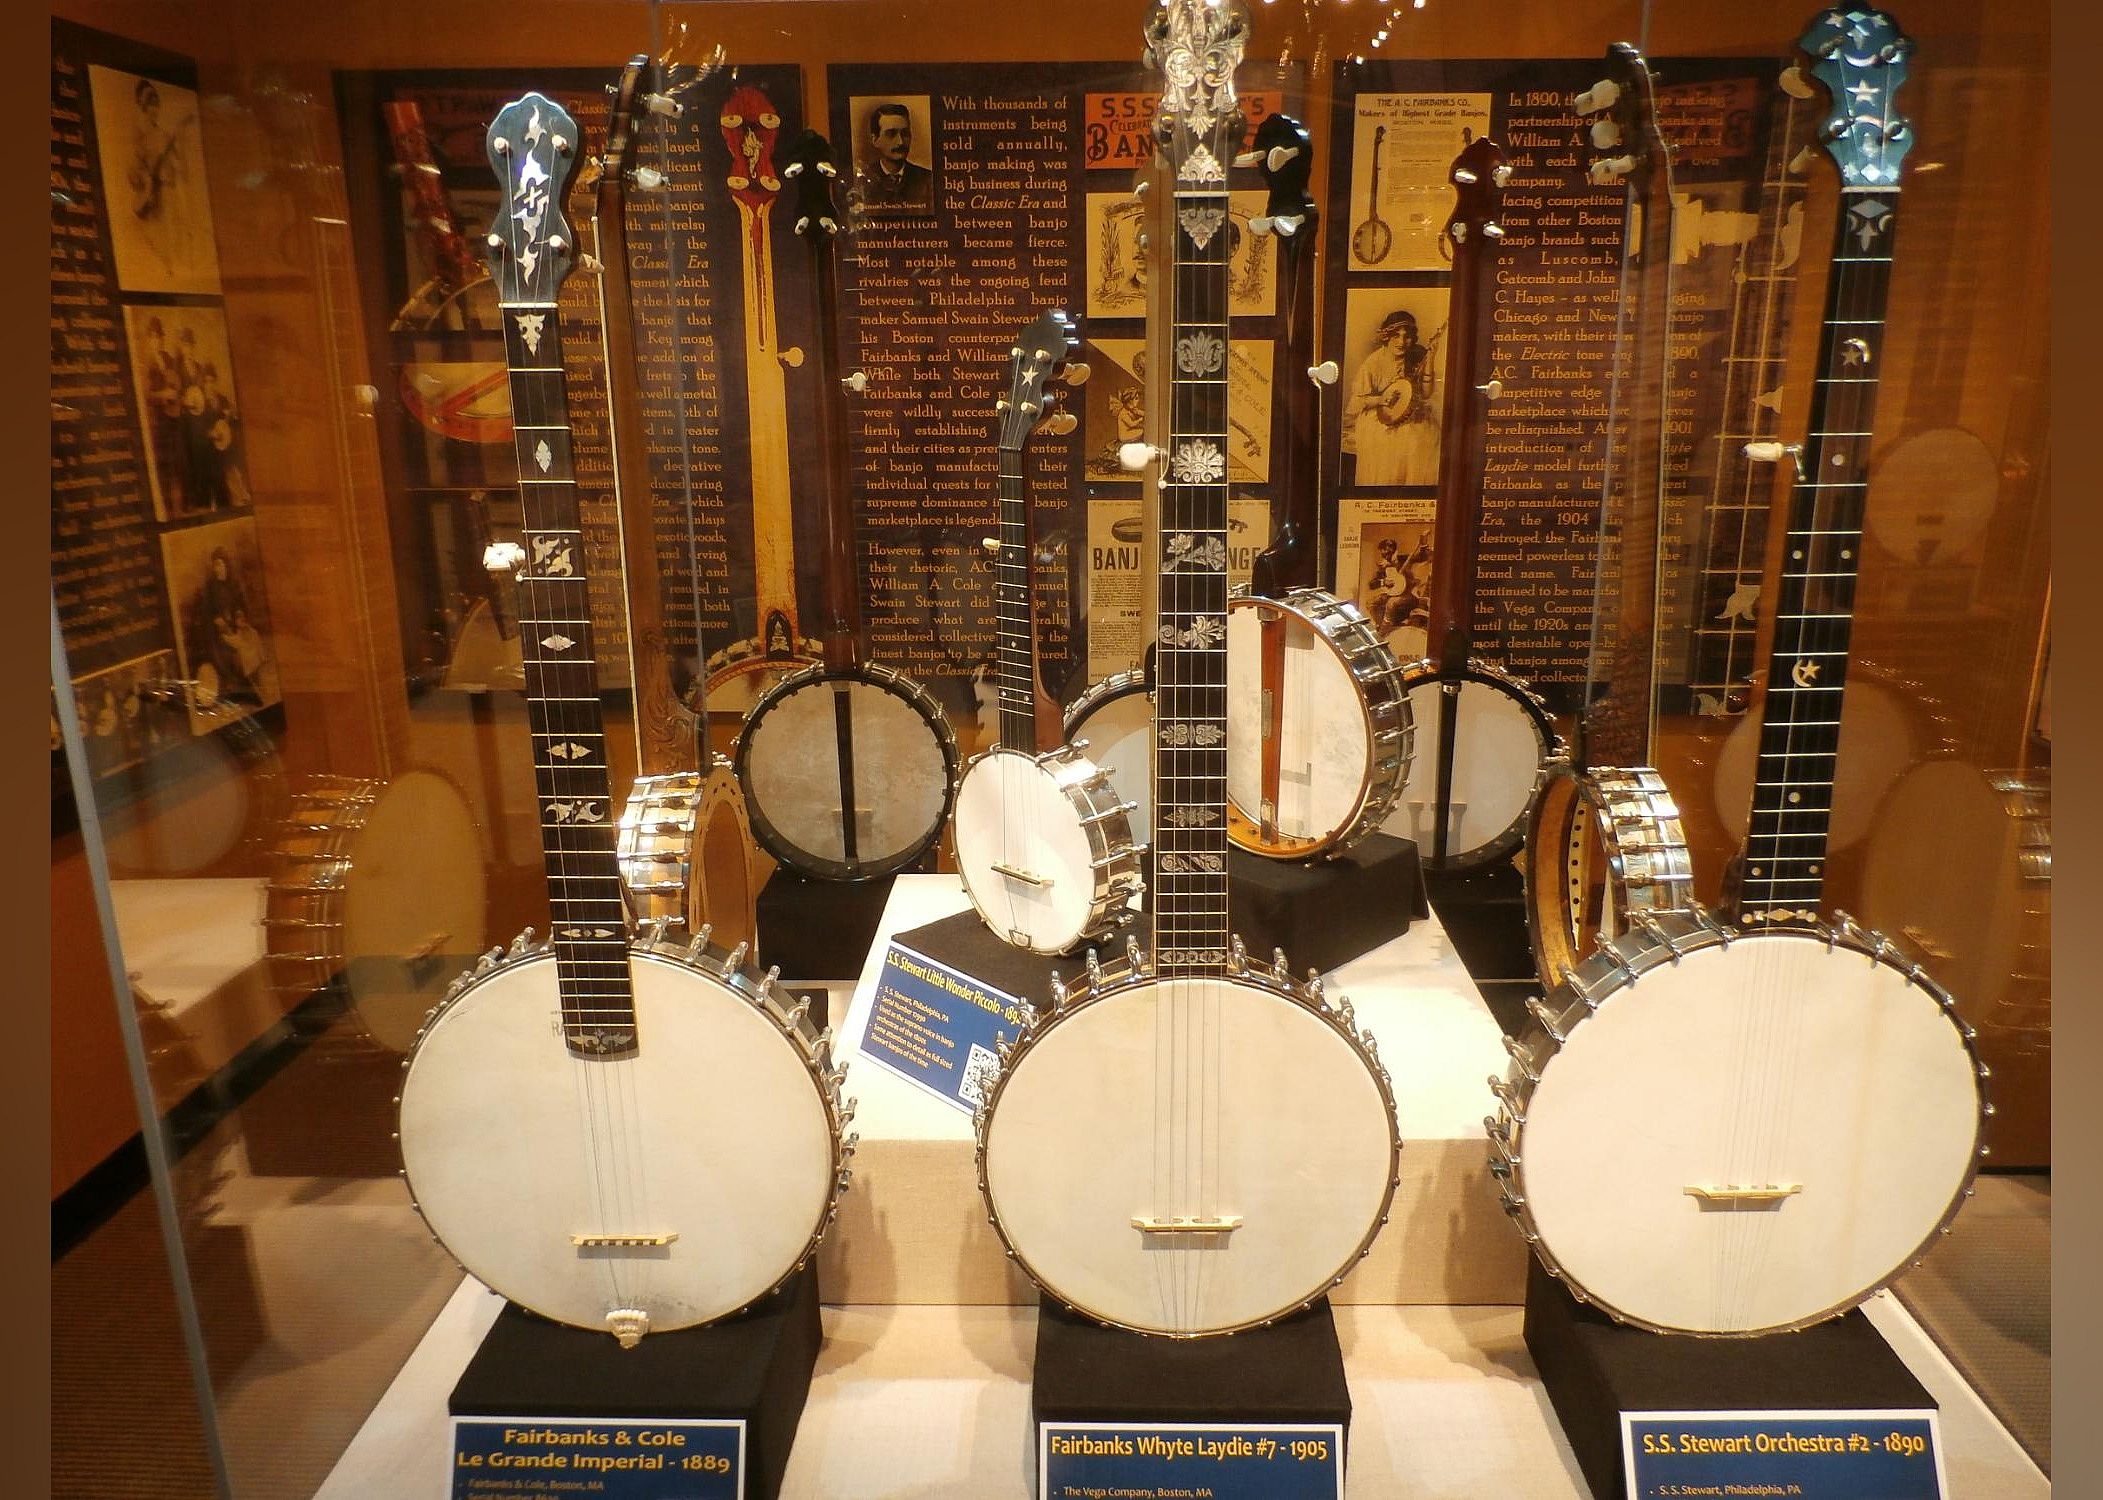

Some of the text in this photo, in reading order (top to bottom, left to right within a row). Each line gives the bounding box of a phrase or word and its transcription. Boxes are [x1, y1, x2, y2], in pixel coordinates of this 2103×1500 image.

[984, 97, 1047, 110] thousands
[943, 117, 1067, 132] instruments being
[943, 137, 973, 150] sold
[1087, 123, 1154, 163] BAN
[1508, 134, 1561, 146] William
[944, 157, 1035, 173] banjo making
[1507, 154, 1576, 167] with each
[970, 177, 1067, 191] business during
[971, 196, 1014, 209] Classic
[1503, 196, 1623, 209] facing competition
[955, 215, 1067, 231] between banjo
[1538, 212, 1621, 225] other Boston
[687, 238, 706, 249] the
[858, 234, 1067, 248] manufacturers became fierce.
[1542, 232, 1619, 245] brands such
[688, 256, 709, 268] Era
[905, 254, 1067, 269] notable among these
[674, 275, 709, 288] which
[859, 273, 1067, 288] rivalries ongoing feud
[1586, 271, 1615, 283] John
[694, 294, 711, 305] for
[860, 292, 1067, 308] between Philadelphia banjo
[1515, 290, 1554, 305] Hayes
[688, 314, 712, 325] that
[861, 311, 988, 325] maker Samuel Swain
[1494, 310, 1547, 324] Chicago
[893, 332, 933, 343] Boston
[1544, 329, 1604, 341] with their
[862, 350, 920, 362] Fairbanks
[1520, 348, 1570, 360] Electric
[696, 369, 715, 381] the
[914, 368, 1000, 380] both Stewart
[1532, 367, 1592, 378] Fairbanks
[683, 387, 716, 399] metal
[863, 387, 990, 399] Fairbanks Cole
[903, 404, 941, 419] wildly
[1488, 404, 1565, 417] marketplace
[915, 424, 986, 436] establishing
[693, 444, 720, 453] tone.
[892, 442, 955, 453] their cities
[1485, 442, 1564, 452] introduction
[890, 460, 922, 473] banjo
[1485, 460, 1528, 473] Laydie
[866, 478, 969, 491] individual quests
[1483, 477, 1543, 489] Fairbanks
[691, 495, 723, 507] which
[866, 496, 987, 509] supreme dominance
[868, 513, 943, 527] marketplace
[1093, 548, 1138, 570] BANJ
[1478, 550, 1584, 563] seemed powerless
[869, 562, 897, 573] their
[1477, 567, 1512, 579] brand
[869, 578, 981, 590] William Cole
[1475, 585, 1535, 596] continued
[704, 601, 730, 612] both
[871, 595, 960, 607] Swain Stewart
[1504, 602, 1535, 615] Vega
[871, 613, 920, 626] produce
[1474, 620, 1501, 631] until
[872, 630, 934, 642] considered
[909, 647, 945, 661] banjos
[901, 956, 926, 979] Stewart
[926, 969, 945, 988] Little
[946, 977, 974, 1000] Wonder
[974, 990, 1000, 1013] Piccolo
[504, 1429, 686, 1446] Fairbanks & Cole
[1643, 1434, 1676, 1453] S.S.
[1679, 1434, 1752, 1453] Stewart
[1755, 1432, 1843, 1453] Orchestra
[1848, 1435, 1870, 1452] #2
[1883, 1432, 1924, 1456] 1890
[1051, 1435, 1133, 1455] Fairbanks
[1137, 1436, 1193, 1460] Whyte
[1198, 1437, 1252, 1461] Laydie
[1256, 1438, 1276, 1460] #7
[1290, 1441, 1328, 1460] 1905
[457, 1451, 484, 1467] Le
[488, 1451, 568, 1468] Grande
[574, 1453, 664, 1473] Imperial
[682, 1455, 730, 1473] 1889
[1064, 1487, 1212, 1498] The Vega Company, Boston, MA
[1682, 1485, 1723, 1495] Stewart,
[1725, 1485, 1785, 1497] Philadelphia,
[1788, 1485, 1801, 1494] PA
